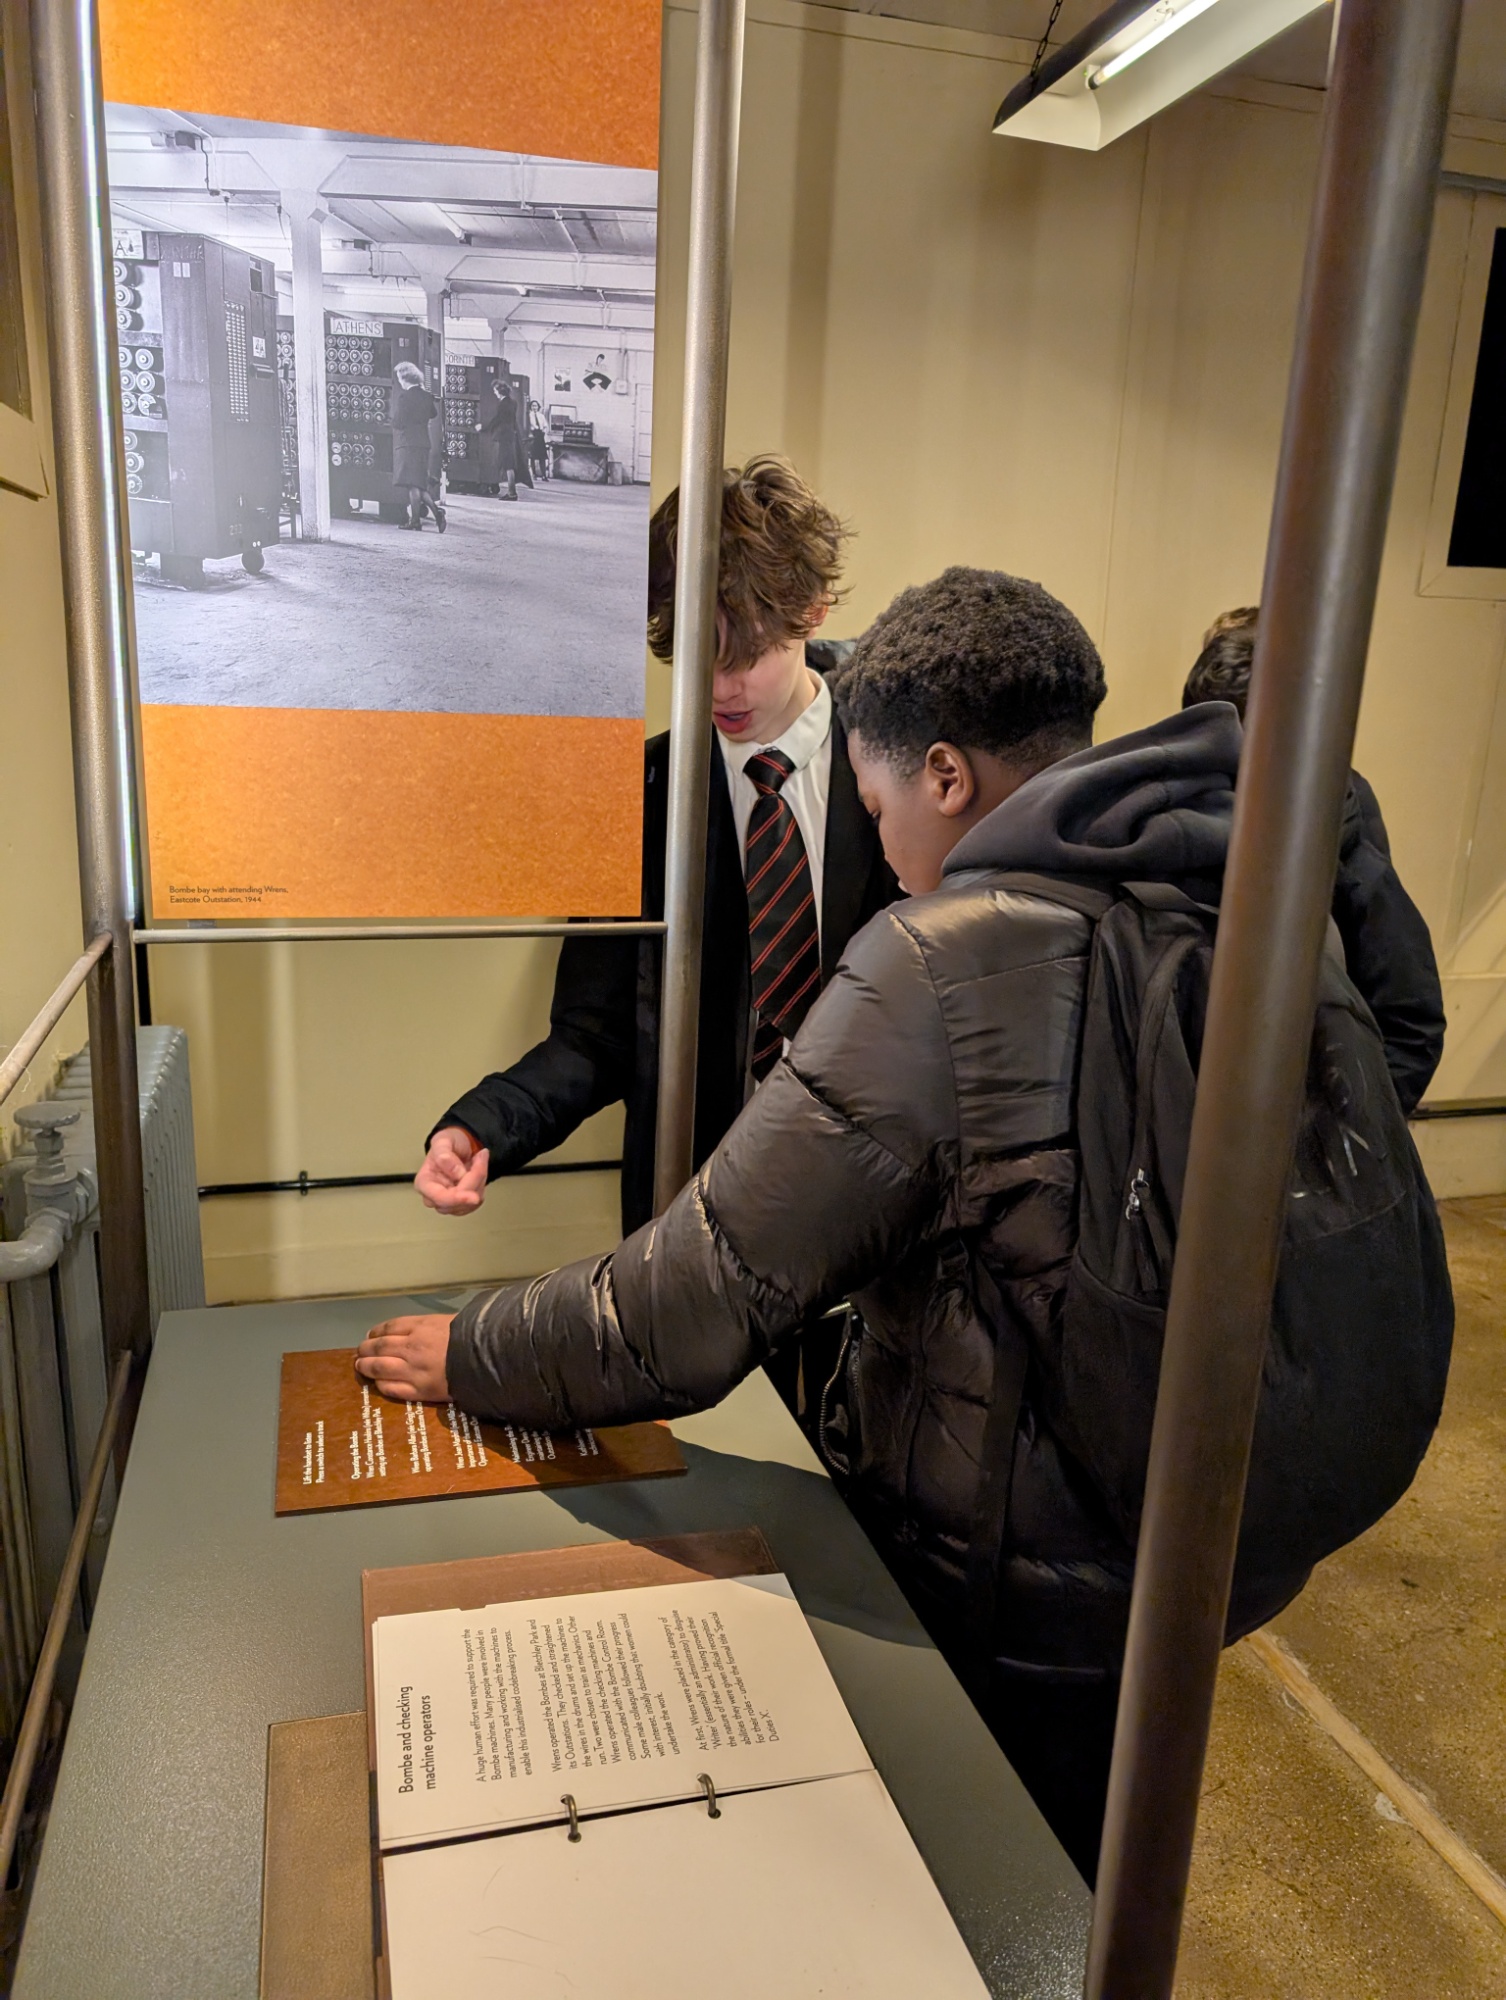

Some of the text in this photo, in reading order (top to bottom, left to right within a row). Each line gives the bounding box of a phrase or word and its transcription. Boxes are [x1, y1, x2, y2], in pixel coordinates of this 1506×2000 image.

[334, 321, 382, 335] ATHENS
[197, 886, 210, 894] bay
[228, 886, 262, 894] attending
[264, 886, 288, 894] Wrens,
[202, 895, 243, 903] Outstation,
[315, 1421, 324, 1432] track
[303, 1432, 312, 1445] listen
[315, 1434, 324, 1448] select
[349, 1431, 359, 1449] Bombes
[303, 1450, 312, 1468] handset
[315, 1453, 324, 1467] switch
[351, 1456, 362, 1479] Operating
[303, 1475, 312, 1484] Lift
[315, 1470, 324, 1483] Press
[527, 1619, 537, 1630] and
[567, 1616, 577, 1633] Other
[672, 1610, 683, 1632] disguise
[687, 1617, 696, 1629] their
[461, 1629, 470, 1639] the
[529, 1631, 539, 1644] Park
[557, 1625, 568, 1652] machines
[664, 1624, 676, 1649] category
[689, 1630, 705, 1650] proved
[718, 1634, 728, 1645] title
[464, 1640, 475, 1662] support
[475, 1636, 486, 1661] involved
[490, 1635, 500, 1662] machines
[573, 1634, 584, 1665] mechanics.
[670, 1650, 679, 1660] the
[721, 1646, 735, 1664] formal
[532, 1645, 544, 1672] Bletchley
[561, 1653, 570, 1663] the
[679, 1640, 699, 1680] administrator)
[699, 1651, 710, 1672] Having
[493, 1663, 502, 1674] the
[565, 1664, 574, 1672] up
[674, 1667, 690, 1687] placed
[730, 1665, 739, 1676] the
[465, 1671, 478, 1697] required
[494, 1674, 503, 1688] with
[566, 1673, 574, 1682] set
[581, 1674, 589, 1688] train
[618, 1613, 665, 1757] with interest, initially doubting that women could
[695, 1681, 702, 1689] an
[701, 1619, 751, 1745] abilities they were given official recognition
[704, 1673, 716, 1689] work.
[734, 1677, 746, 1694] under
[480, 1677, 494, 1699] people
[538, 1680, 550, 1706] Bombes
[541, 1625, 577, 1769] its Outstations. They checked and straightened
[566, 1683, 577, 1695] and
[582, 1630, 621, 1763] Wrens operated the checking machines and
[597, 1620, 636, 1761] communicated with the Bombe Control Room.
[610, 1622, 651, 1759] Some male colleagues followed their progress
[684, 1688, 693, 1703] were
[497, 1688, 507, 1714] working
[505, 1630, 532, 1775] enable this industrialised codebreaking process.
[572, 1696, 581, 1716] drums
[696, 1690, 716, 1723] (essentially
[711, 1690, 722, 1705] their
[484, 1700, 495, 1719] Many
[543, 1706, 552, 1717] the
[586, 1697, 596, 1719] chosen
[688, 1704, 699, 1726] Wrens
[743, 1701, 755, 1716] roles
[470, 1711, 480, 1730] effort
[499, 1715, 510, 1727] and
[574, 1718, 584, 1729] the
[592, 1720, 600, 1736] were
[655, 1692, 680, 1755] undertake the work.
[721, 1714, 732, 1735] nature
[749, 1717, 761, 1733] their
[396, 1686, 413, 1793] Bombe and checking
[487, 1720, 498, 1753] machines.
[544, 1718, 559, 1748] operated
[695, 1726, 705, 1741] first,
[755, 1734, 765, 1743] for
[766, 1720, 779, 1742] Duties
[420, 1695, 436, 1790] machine operators
[473, 1731, 483, 1755] human
[580, 1737, 589, 1754] wires
[594, 1737, 603, 1751] Two
[699, 1742, 709, 1750] At
[727, 1736, 737, 1747] the
[503, 1728, 516, 1778] manufacturing
[551, 1749, 562, 1772] Wrens
[582, 1755, 592, 1767] the
[599, 1751, 607, 1765] run.
[476, 1756, 487, 1775] huge
[490, 1754, 502, 1781] Bombe
